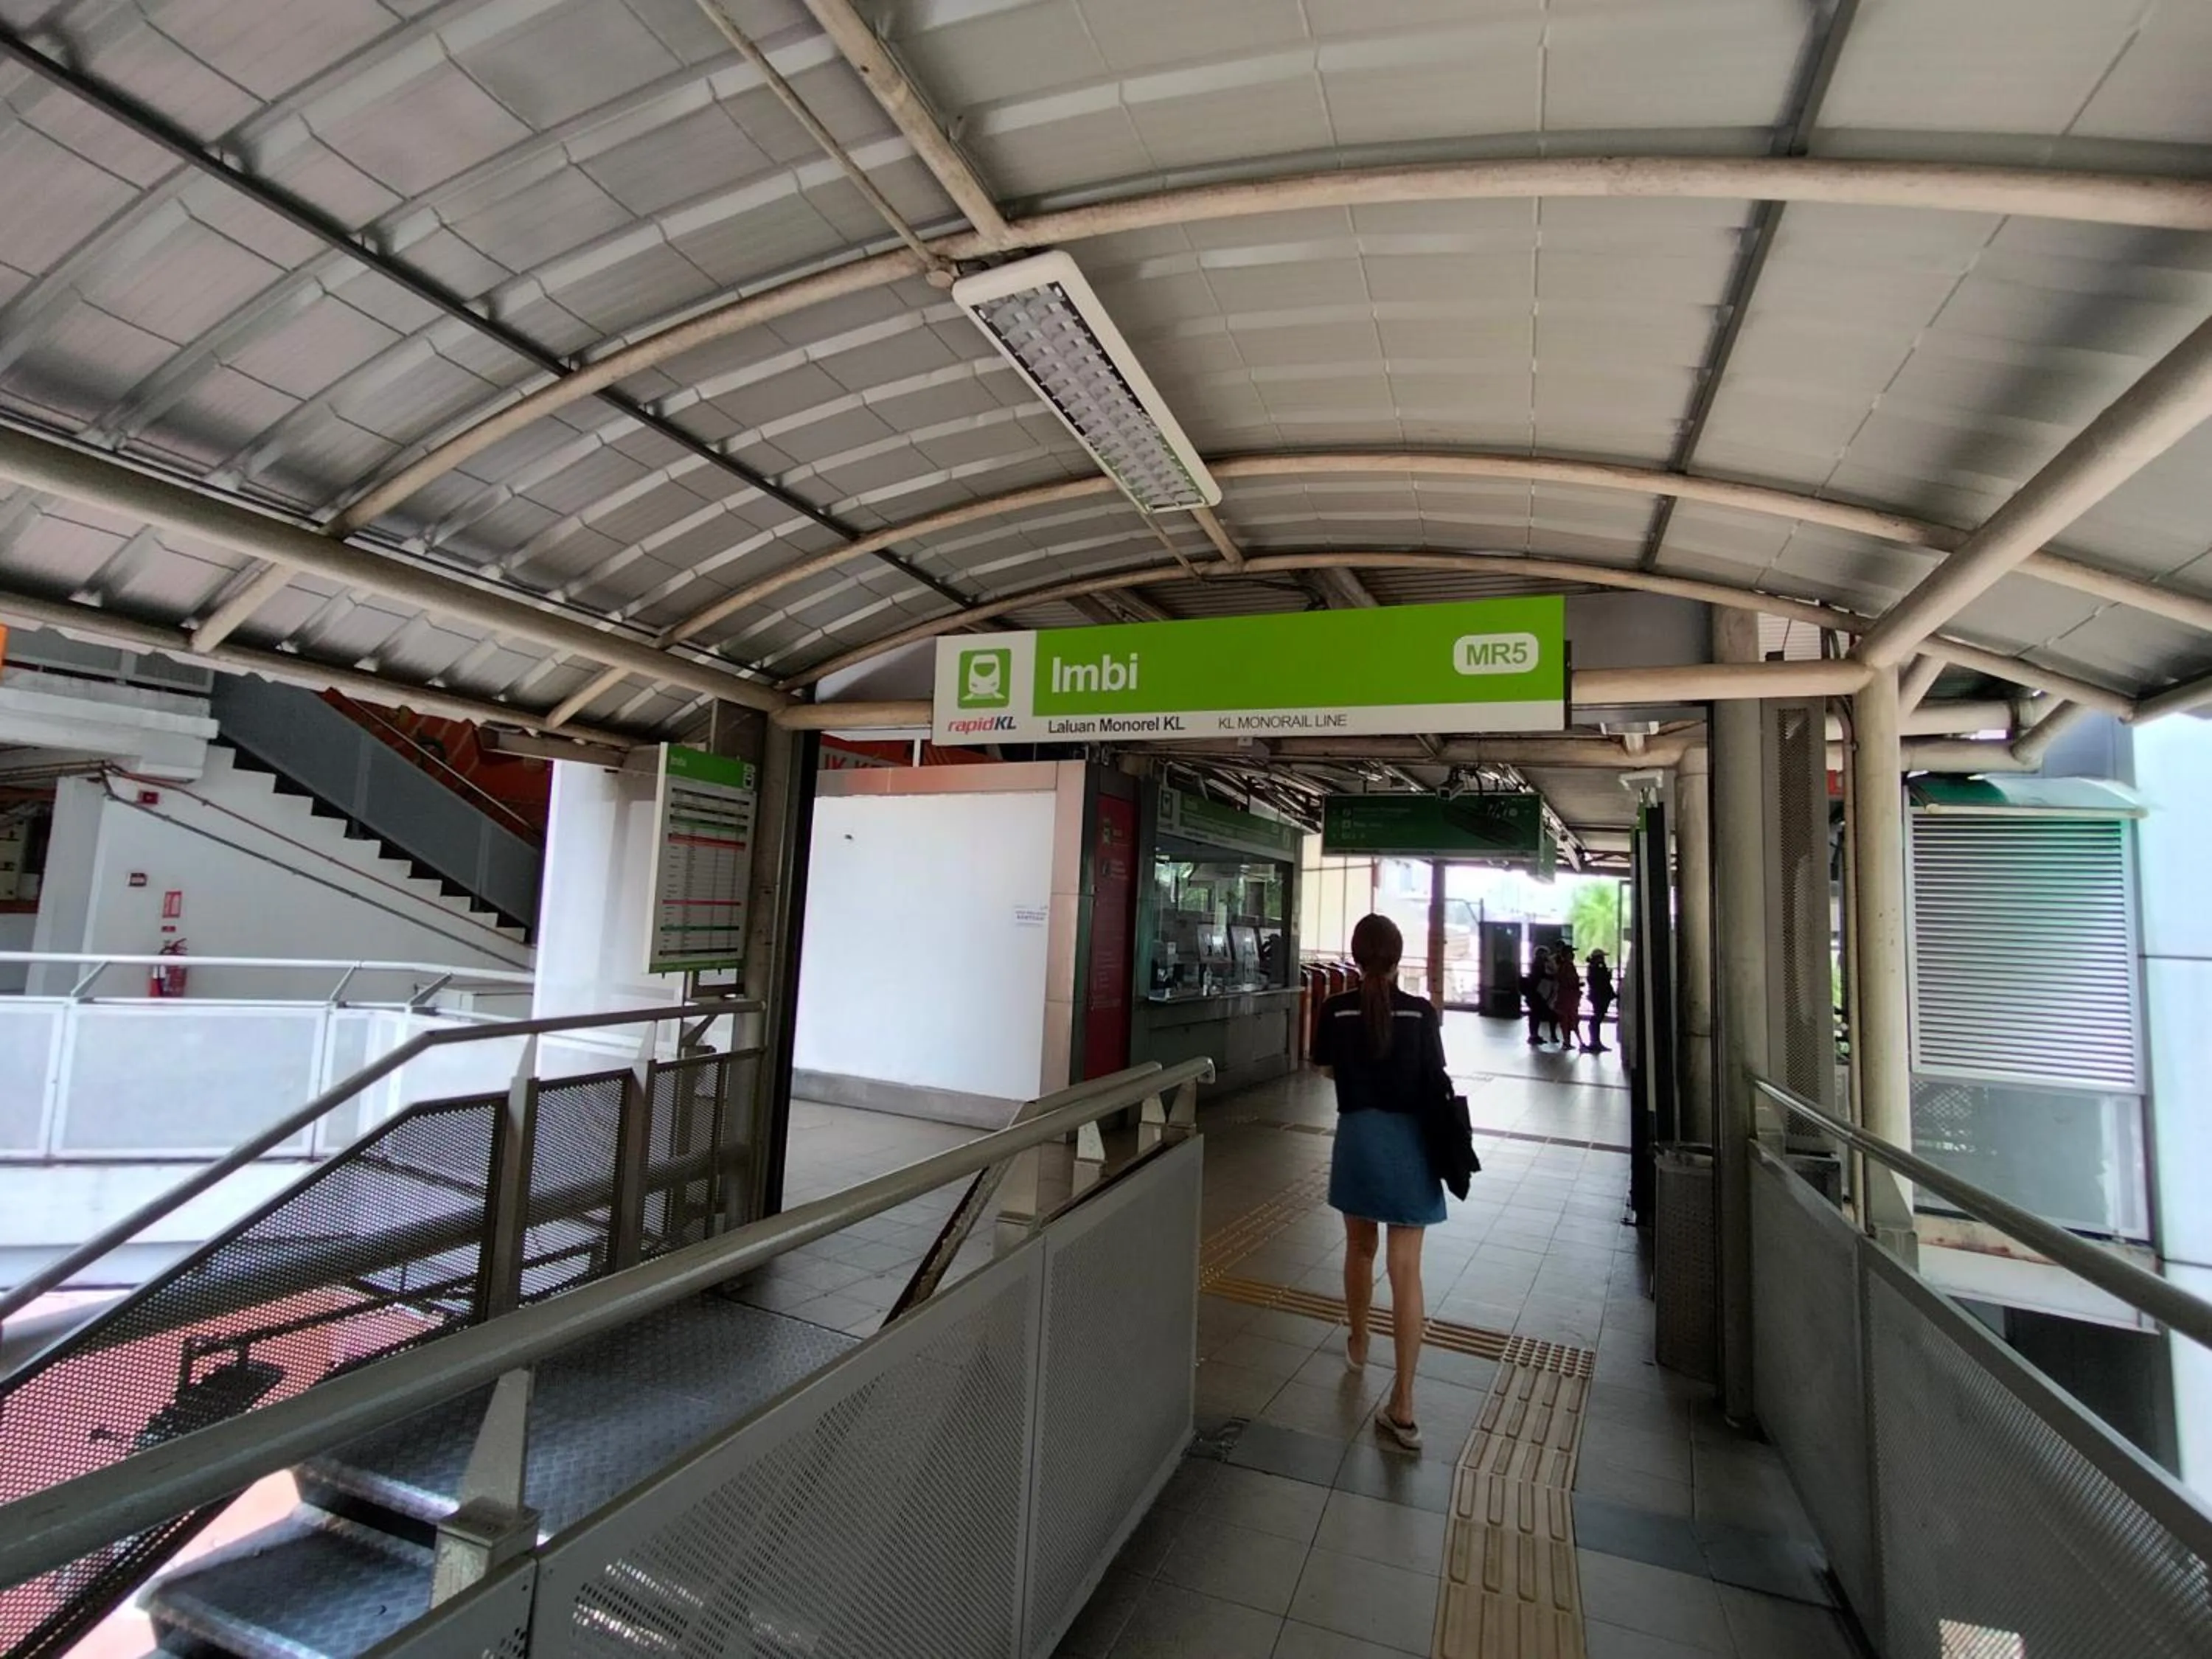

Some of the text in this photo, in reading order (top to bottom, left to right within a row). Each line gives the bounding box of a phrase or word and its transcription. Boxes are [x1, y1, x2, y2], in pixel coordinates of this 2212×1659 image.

[1465, 641, 1528, 666] MR5
[1051, 653, 1139, 693] Imbi
[947, 716, 1018, 735] rapidKL
[1048, 716, 1186, 734] Laluan Monorel KL
[1218, 714, 1348, 729] KL MONORAIL LINE
